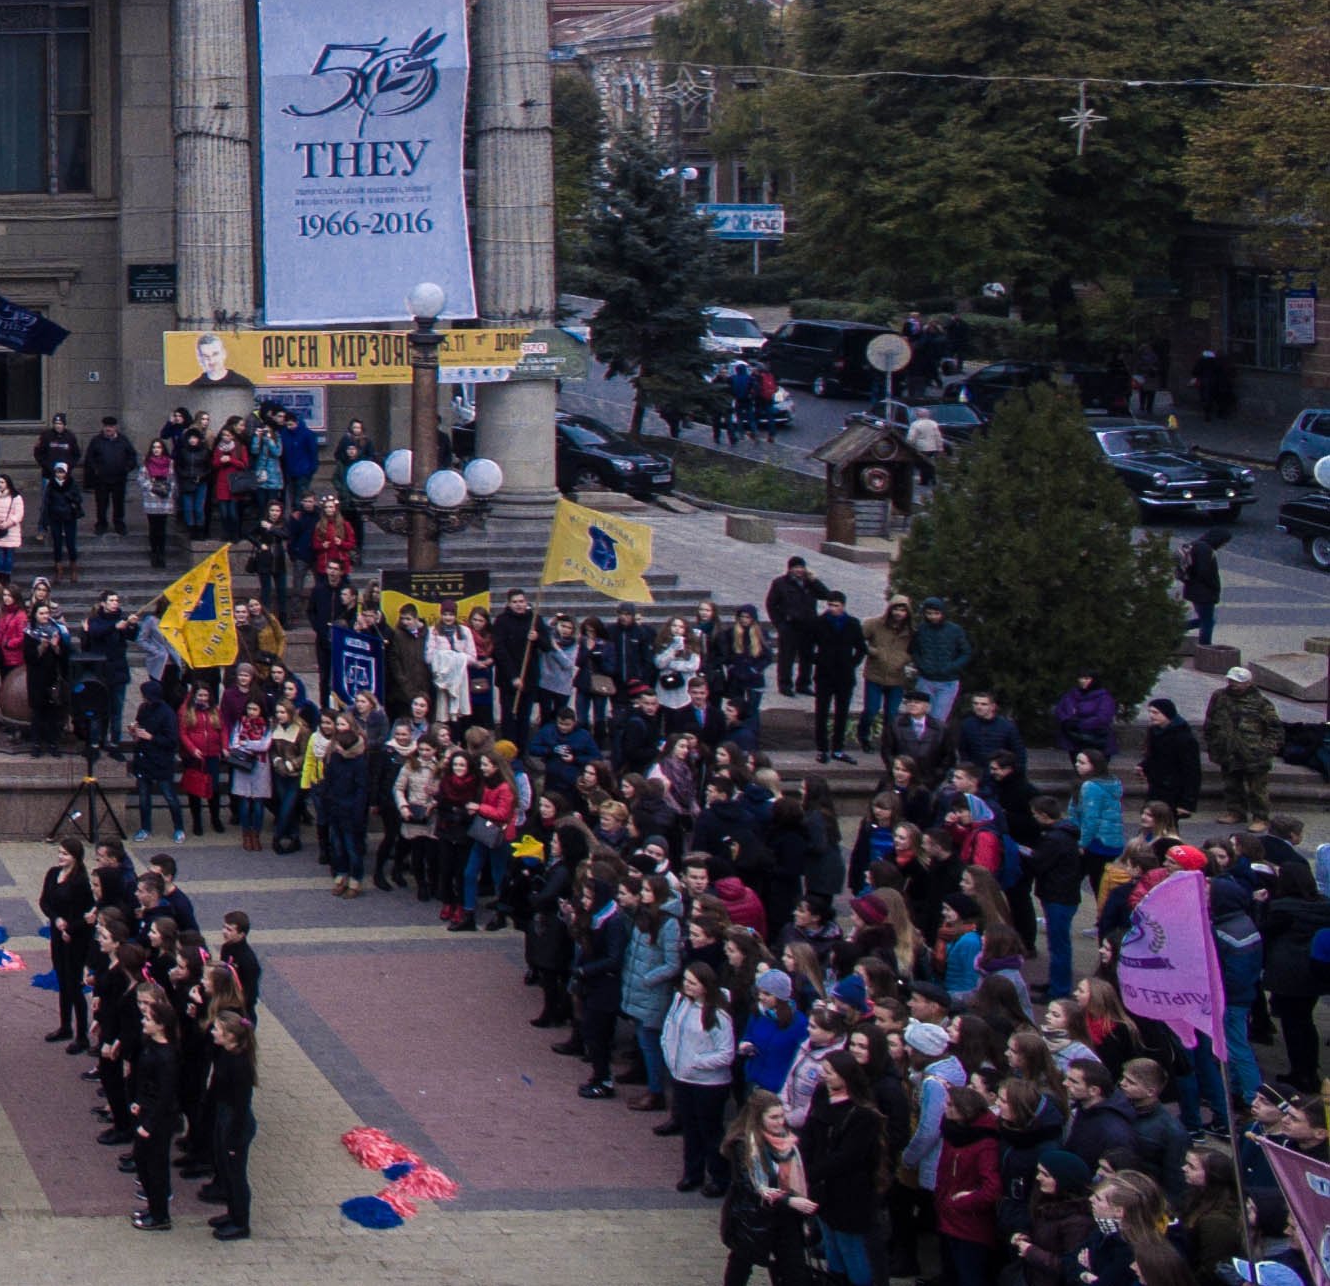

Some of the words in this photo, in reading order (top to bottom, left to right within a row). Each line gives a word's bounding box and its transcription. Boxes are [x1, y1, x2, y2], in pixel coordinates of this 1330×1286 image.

[294, 139, 431, 178] ТНЕУ
[297, 209, 433, 239] 1966-2016
[263, 335, 318, 367] АРСЕН
